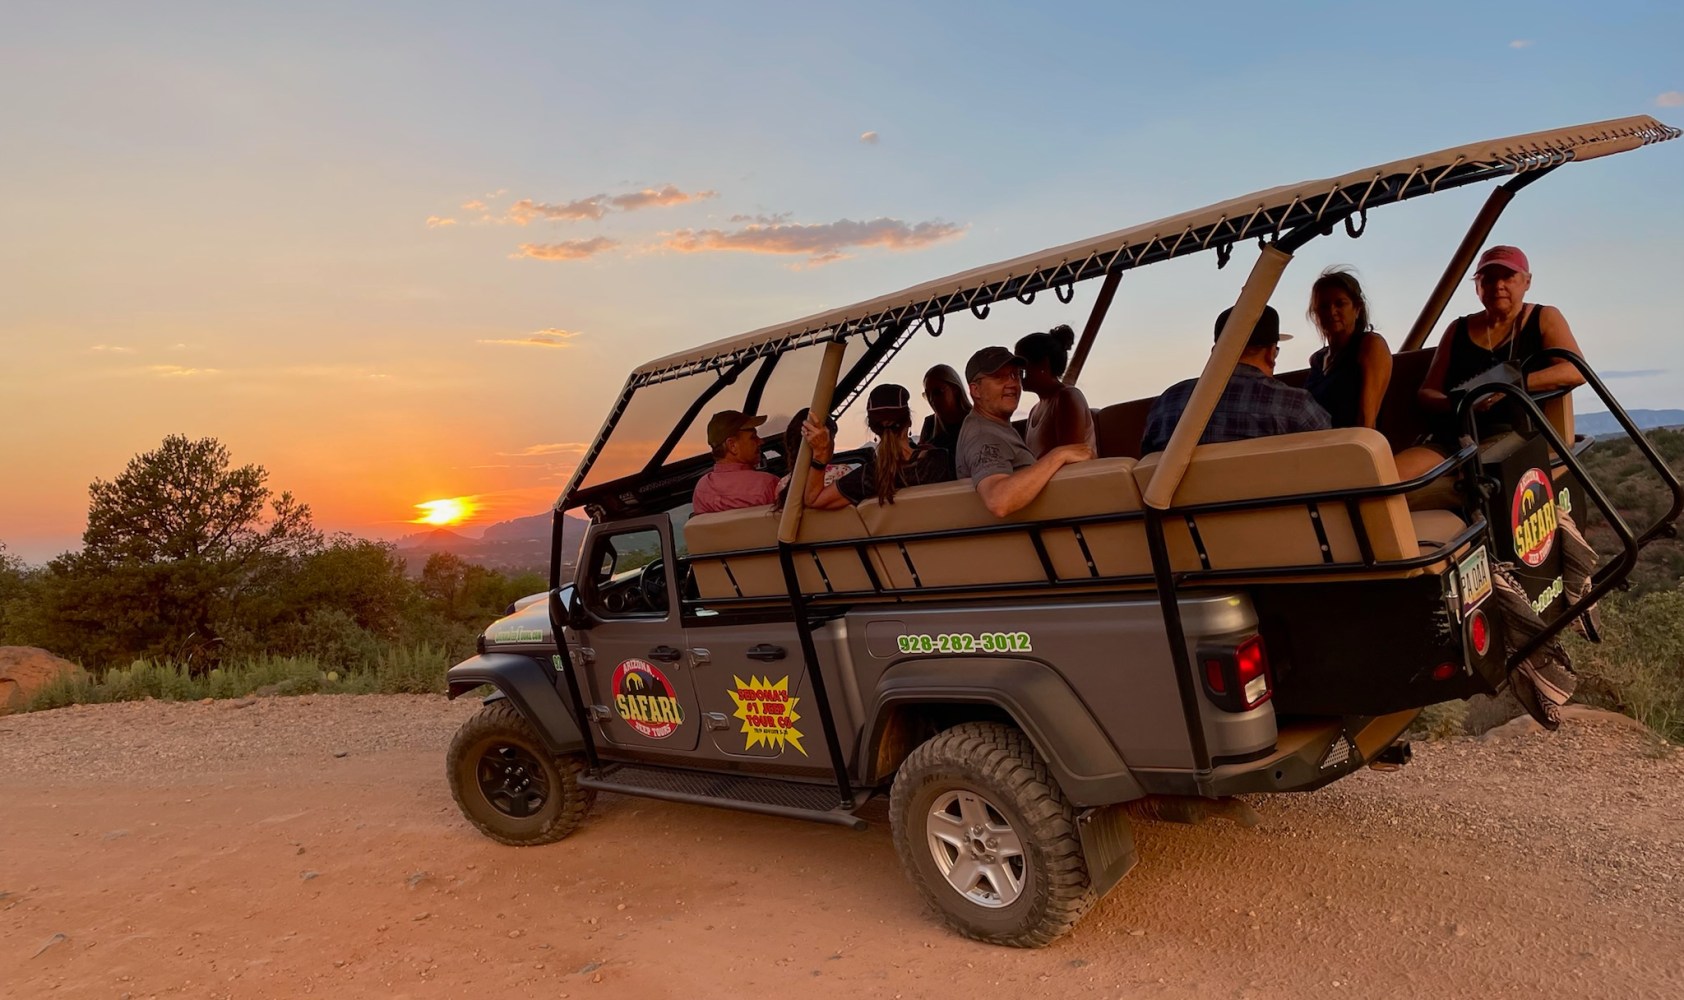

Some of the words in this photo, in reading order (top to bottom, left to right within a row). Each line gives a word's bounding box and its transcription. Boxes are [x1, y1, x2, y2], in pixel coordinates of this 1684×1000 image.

[1515, 499, 1558, 558] SAFARI
[898, 632, 1032, 653] 928-282-3012
[623, 660, 653, 675] ARIZONA
[738, 688, 788, 702] SEDONA'S
[617, 694, 682, 725] SAFARI
[763, 703, 785, 715] JEEP
[746, 715, 776, 727] TOUR
[635, 721, 651, 735] JEEP
[652, 724, 671, 737] TOURS
